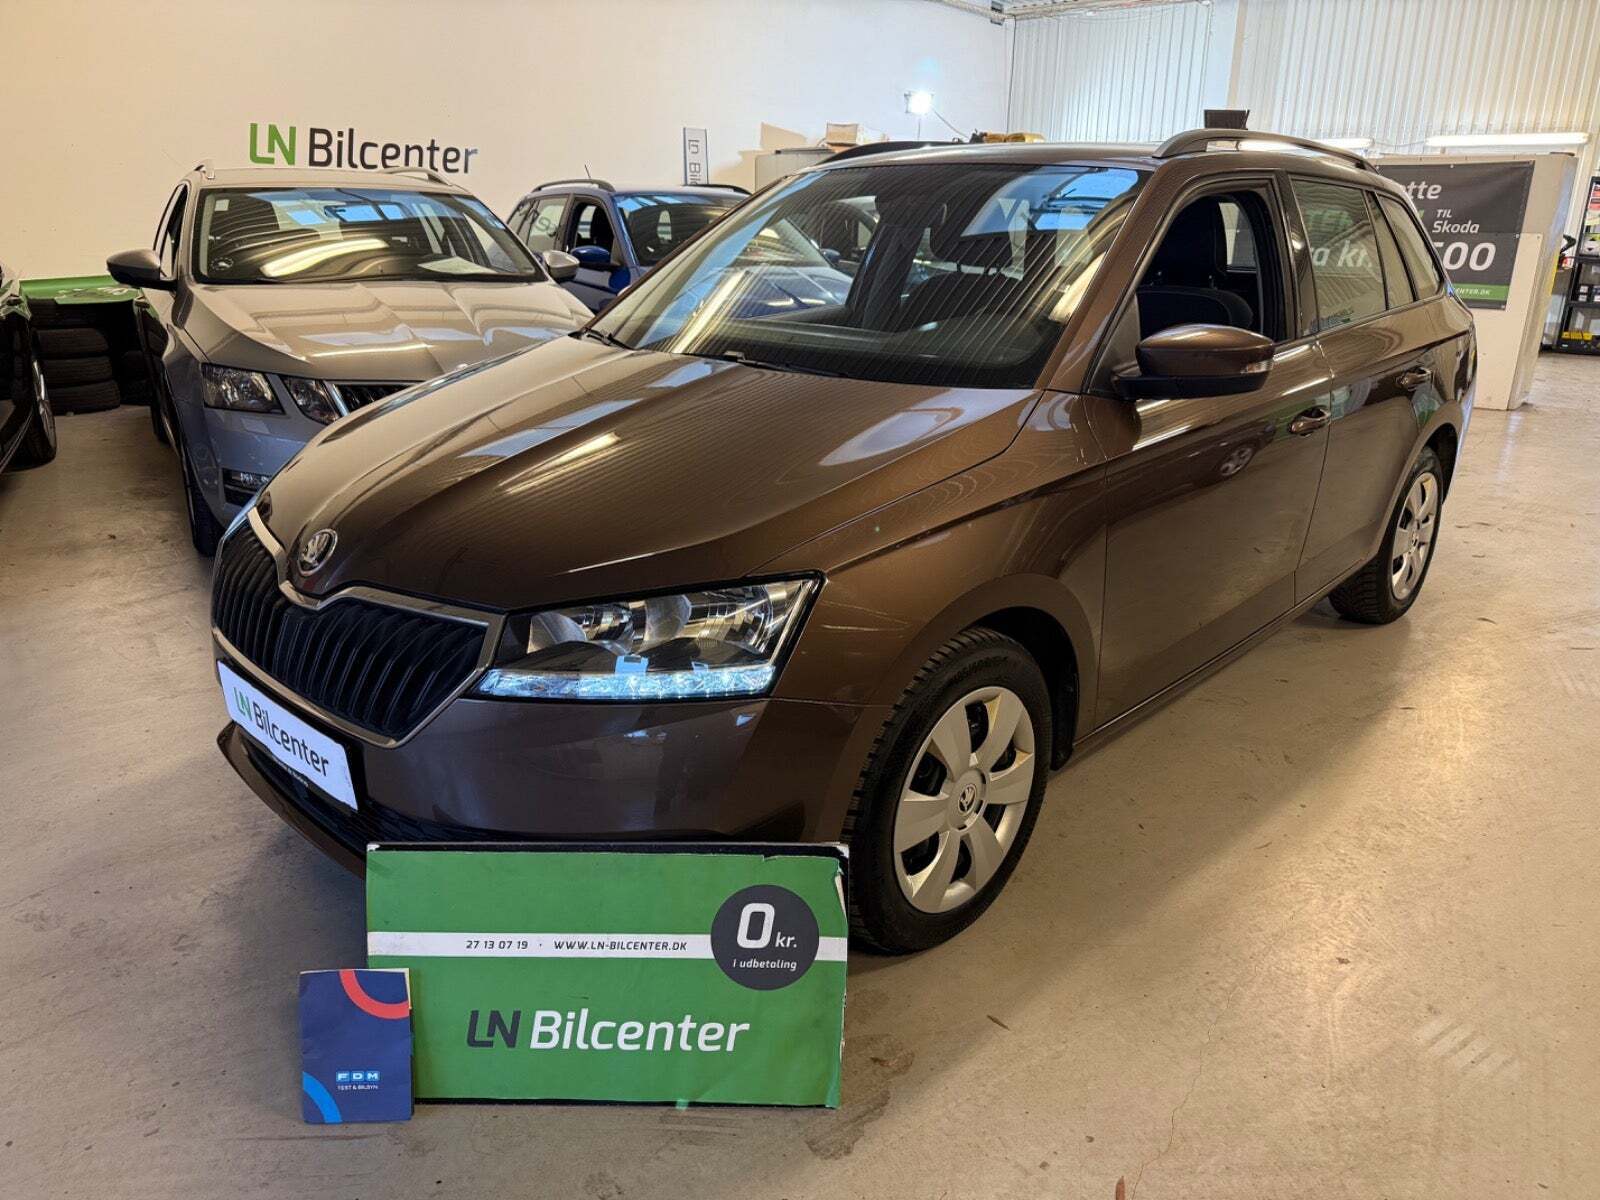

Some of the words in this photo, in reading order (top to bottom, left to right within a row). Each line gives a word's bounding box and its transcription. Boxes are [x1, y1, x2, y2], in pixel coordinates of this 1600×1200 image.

[249, 122, 297, 166] LN
[308, 127, 478, 174] Bilcenter
[1403, 181, 1442, 200] tte
[1436, 208, 1453, 218] TIL
[1431, 219, 1480, 234] Skoda
[1433, 241, 1497, 271] 00
[233, 686, 253, 722] LN
[253, 700, 329, 777] Bilcenter
[736, 902, 775, 949] 0
[775, 931, 798, 948] kr.
[466, 940, 480, 950] 27
[483, 940, 495, 950] 13
[499, 940, 513, 950] 07
[516, 940, 529, 950] 19
[553, 940, 688, 952] WWW.LN-BILCENTER.DK
[739, 958, 797, 972] udbetaling
[466, 1009, 522, 1049] LN
[529, 1007, 751, 1052] Bilcenter
[337, 1072, 379, 1081] FDM
